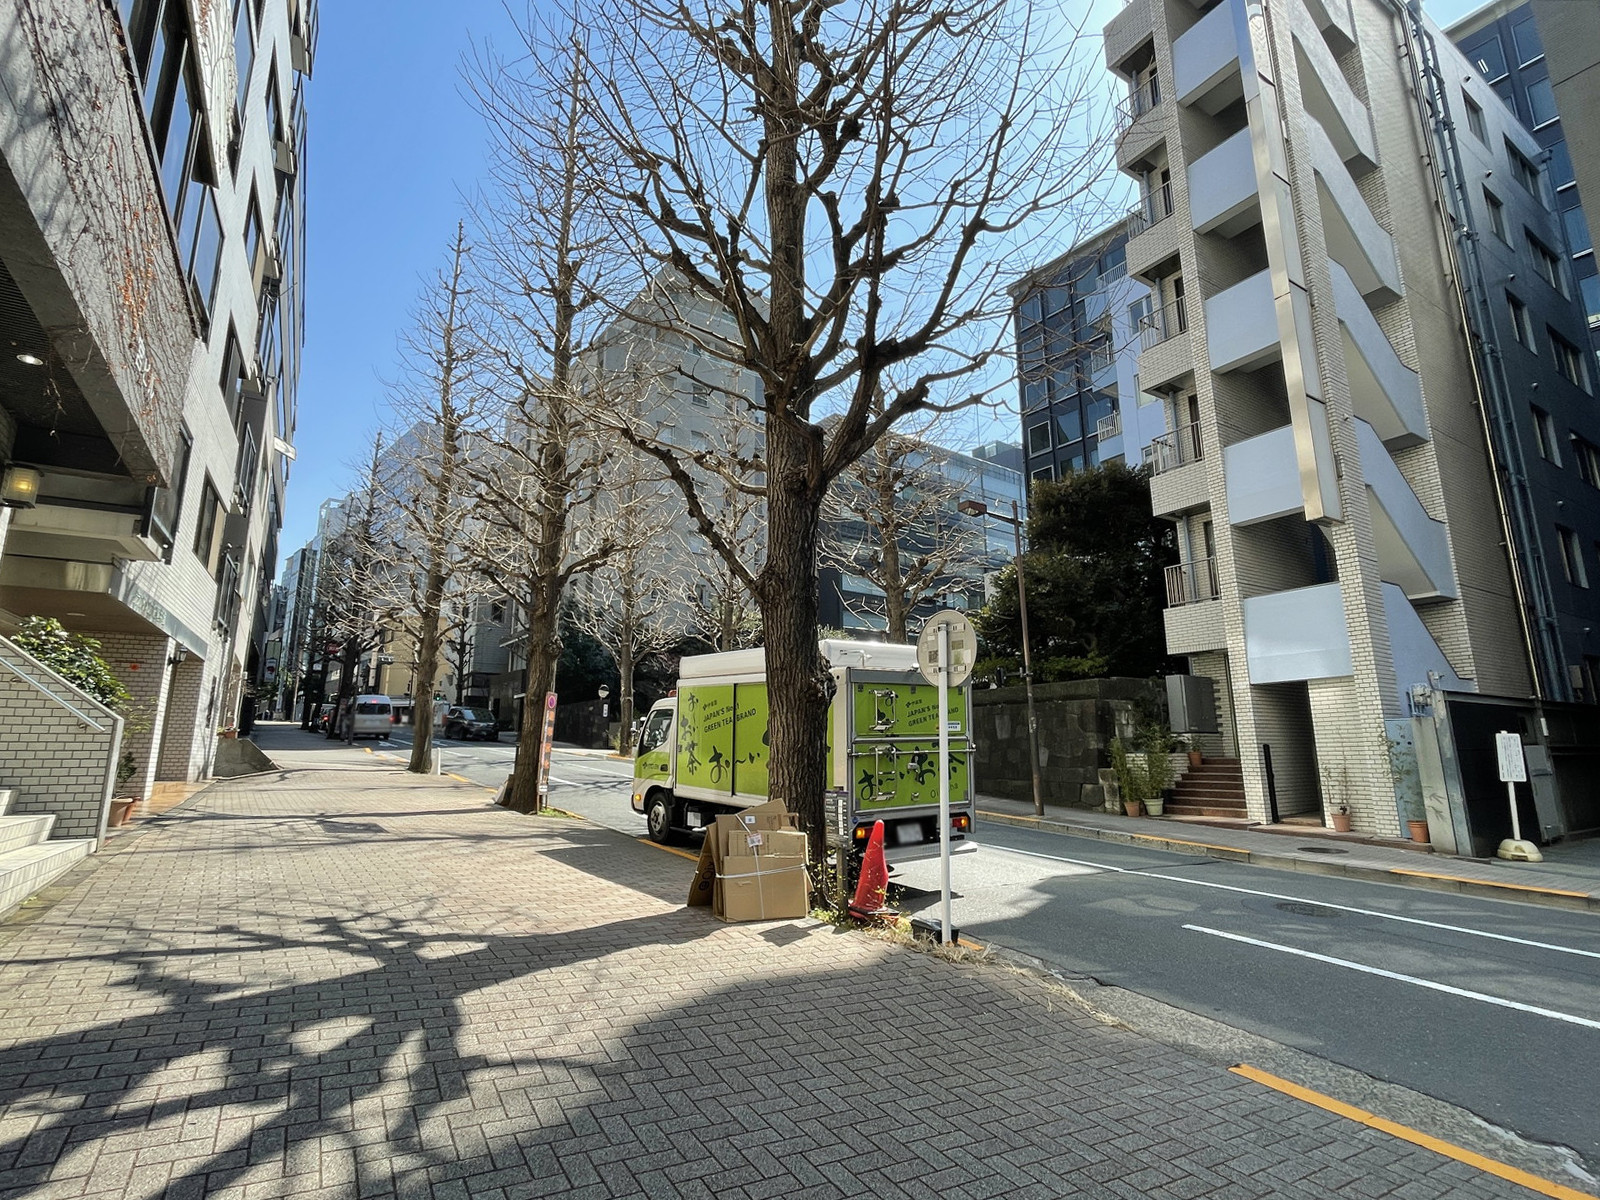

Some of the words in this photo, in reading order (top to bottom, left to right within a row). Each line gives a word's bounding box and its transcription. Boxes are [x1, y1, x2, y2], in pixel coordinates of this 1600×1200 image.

[703, 707, 725, 722] JAPAN'S
[907, 705, 931, 718] JAPAN'S
[703, 721, 721, 733] GREEN
[722, 716, 733, 726] TEA
[736, 708, 757, 722] BRAND
[908, 716, 928, 727] GREEN
